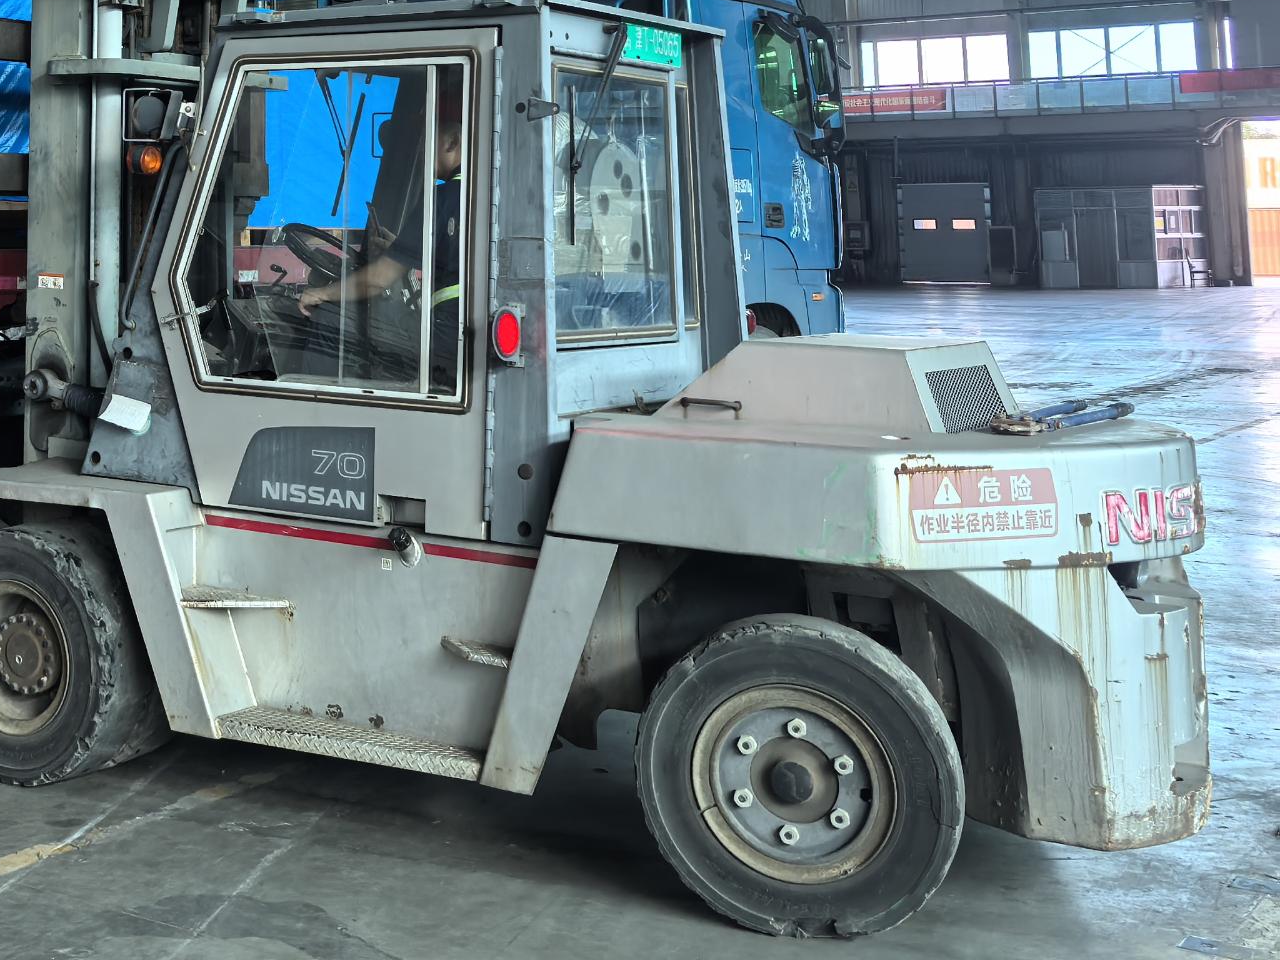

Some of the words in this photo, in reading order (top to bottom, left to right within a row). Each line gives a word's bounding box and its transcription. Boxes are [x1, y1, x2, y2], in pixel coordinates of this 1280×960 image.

[311, 449, 366, 479] 70
[261, 480, 365, 511] NISSAN
[977, 474, 1033, 503] 危险
[920, 508, 1054, 536] 作业半径内禁止靠近
